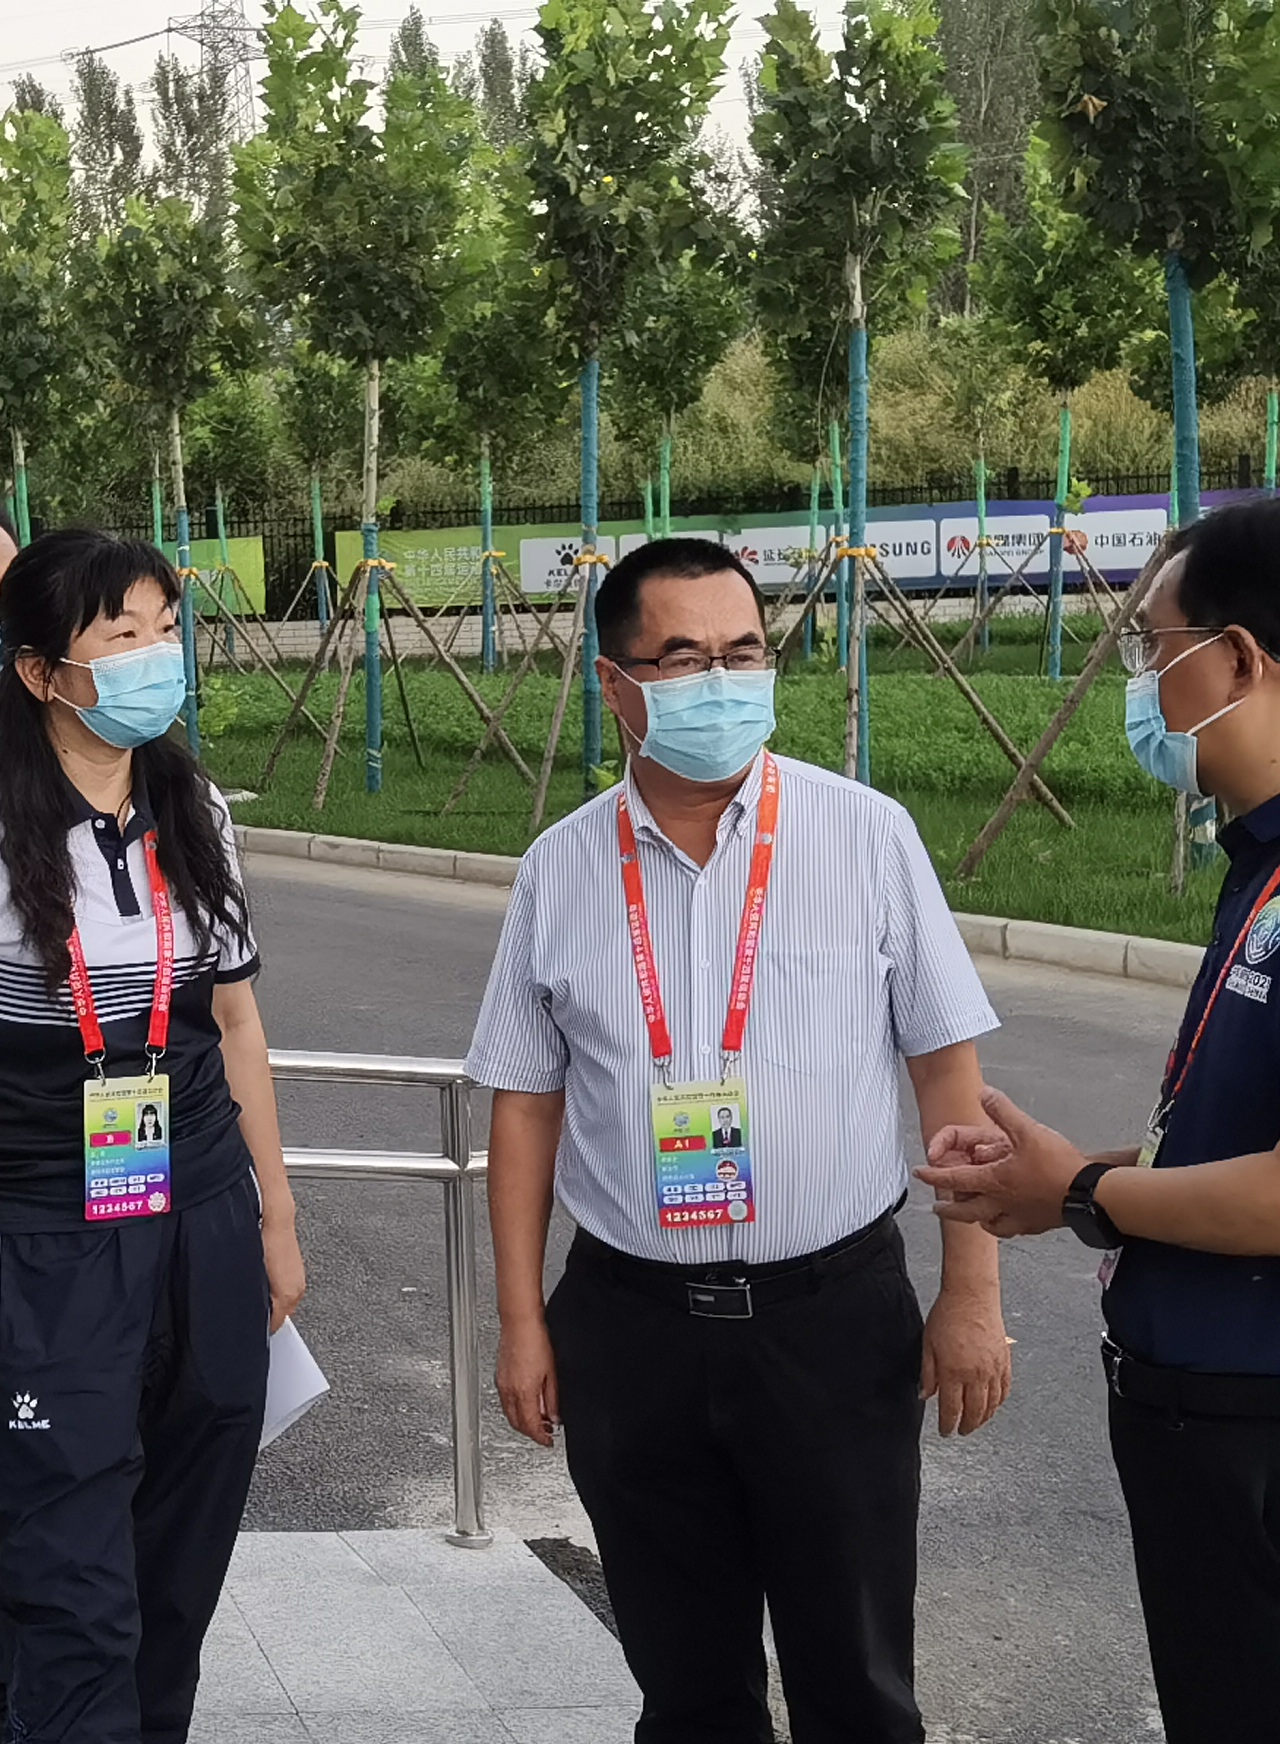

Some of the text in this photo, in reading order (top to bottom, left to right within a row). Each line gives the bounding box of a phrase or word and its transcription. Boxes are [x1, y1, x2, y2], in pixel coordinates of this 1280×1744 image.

[866, 541, 932, 557] SUNG
[674, 1139, 689, 1150] A1
[92, 1200, 144, 1215] 1234567
[666, 1208, 724, 1222] 1234567
[8, 1418, 51, 1430] KELME
